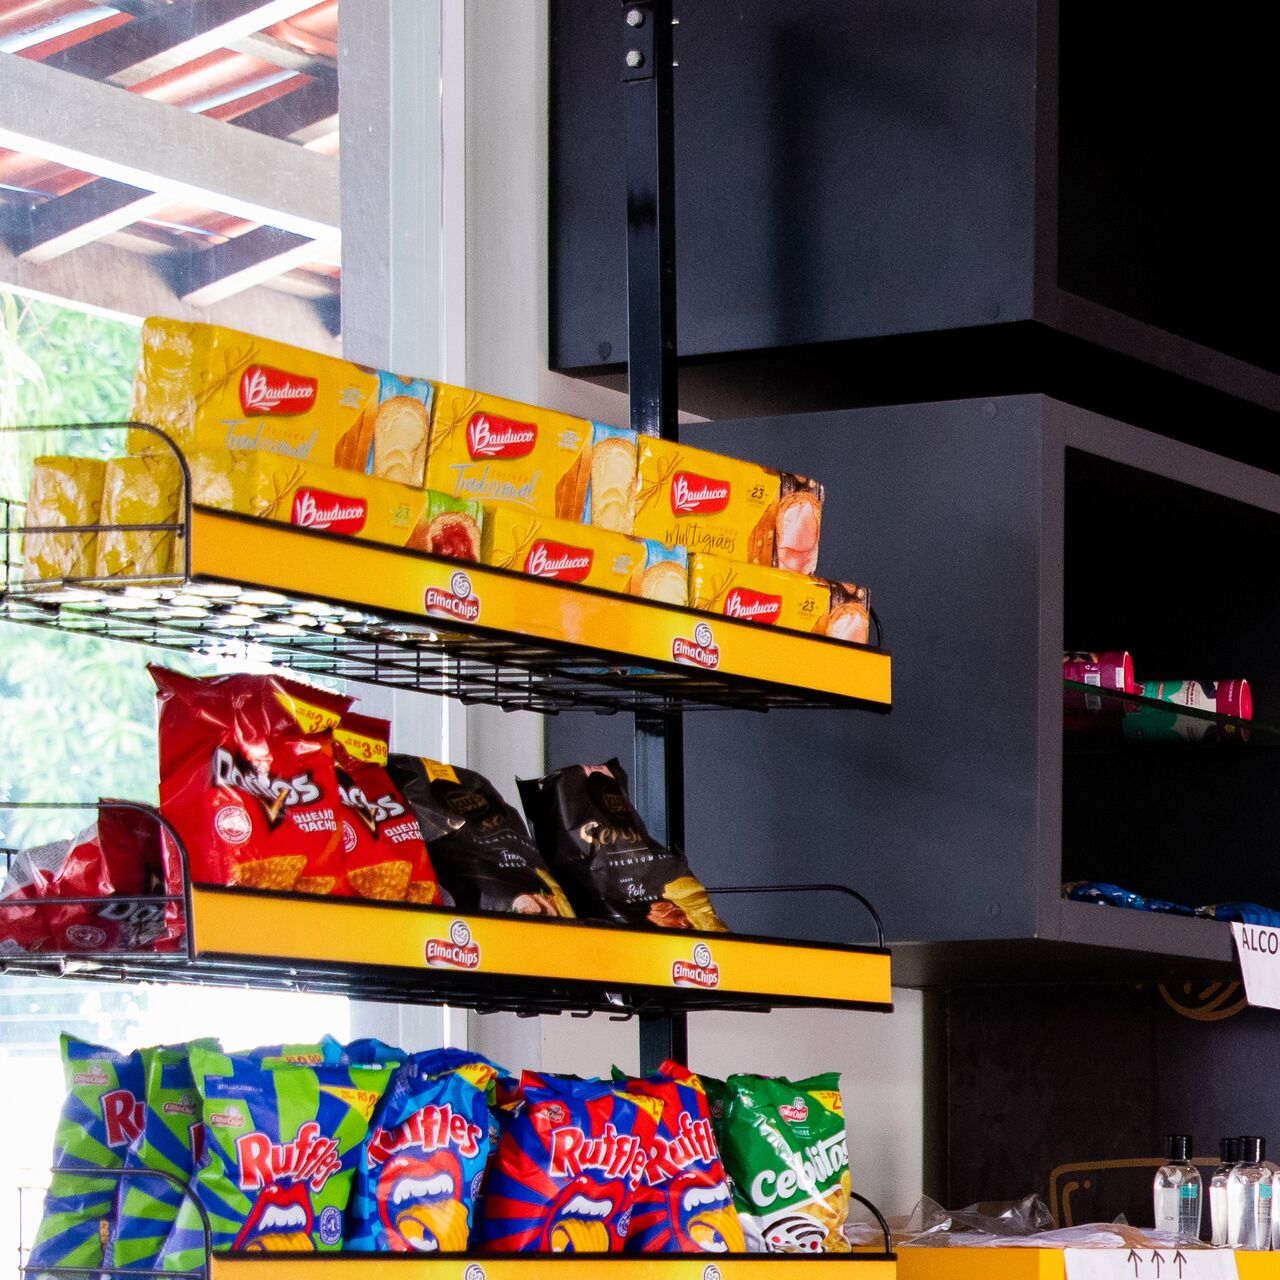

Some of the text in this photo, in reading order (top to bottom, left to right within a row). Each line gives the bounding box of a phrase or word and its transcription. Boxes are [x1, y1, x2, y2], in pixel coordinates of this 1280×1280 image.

[244, 367, 314, 407] Bauducco
[470, 413, 534, 453] Bauducco
[293, 490, 364, 527] Bauducco
[673, 475, 728, 509] Bauducco
[530, 542, 590, 577] Bauducco
[726, 588, 780, 619] Bauducco
[362, 741, 388, 760] 3,99
[211, 746, 321, 806] Doritos
[292, 808, 335, 824] QUEIJO
[298, 822, 337, 833] NACHO
[384, 819, 421, 838] QUEIJ
[391, 828, 424, 844] NACH
[237, 1122, 342, 1192] Ruffles
[550, 1123, 648, 1190] Ruffle
[647, 1111, 716, 1186] Ruffl
